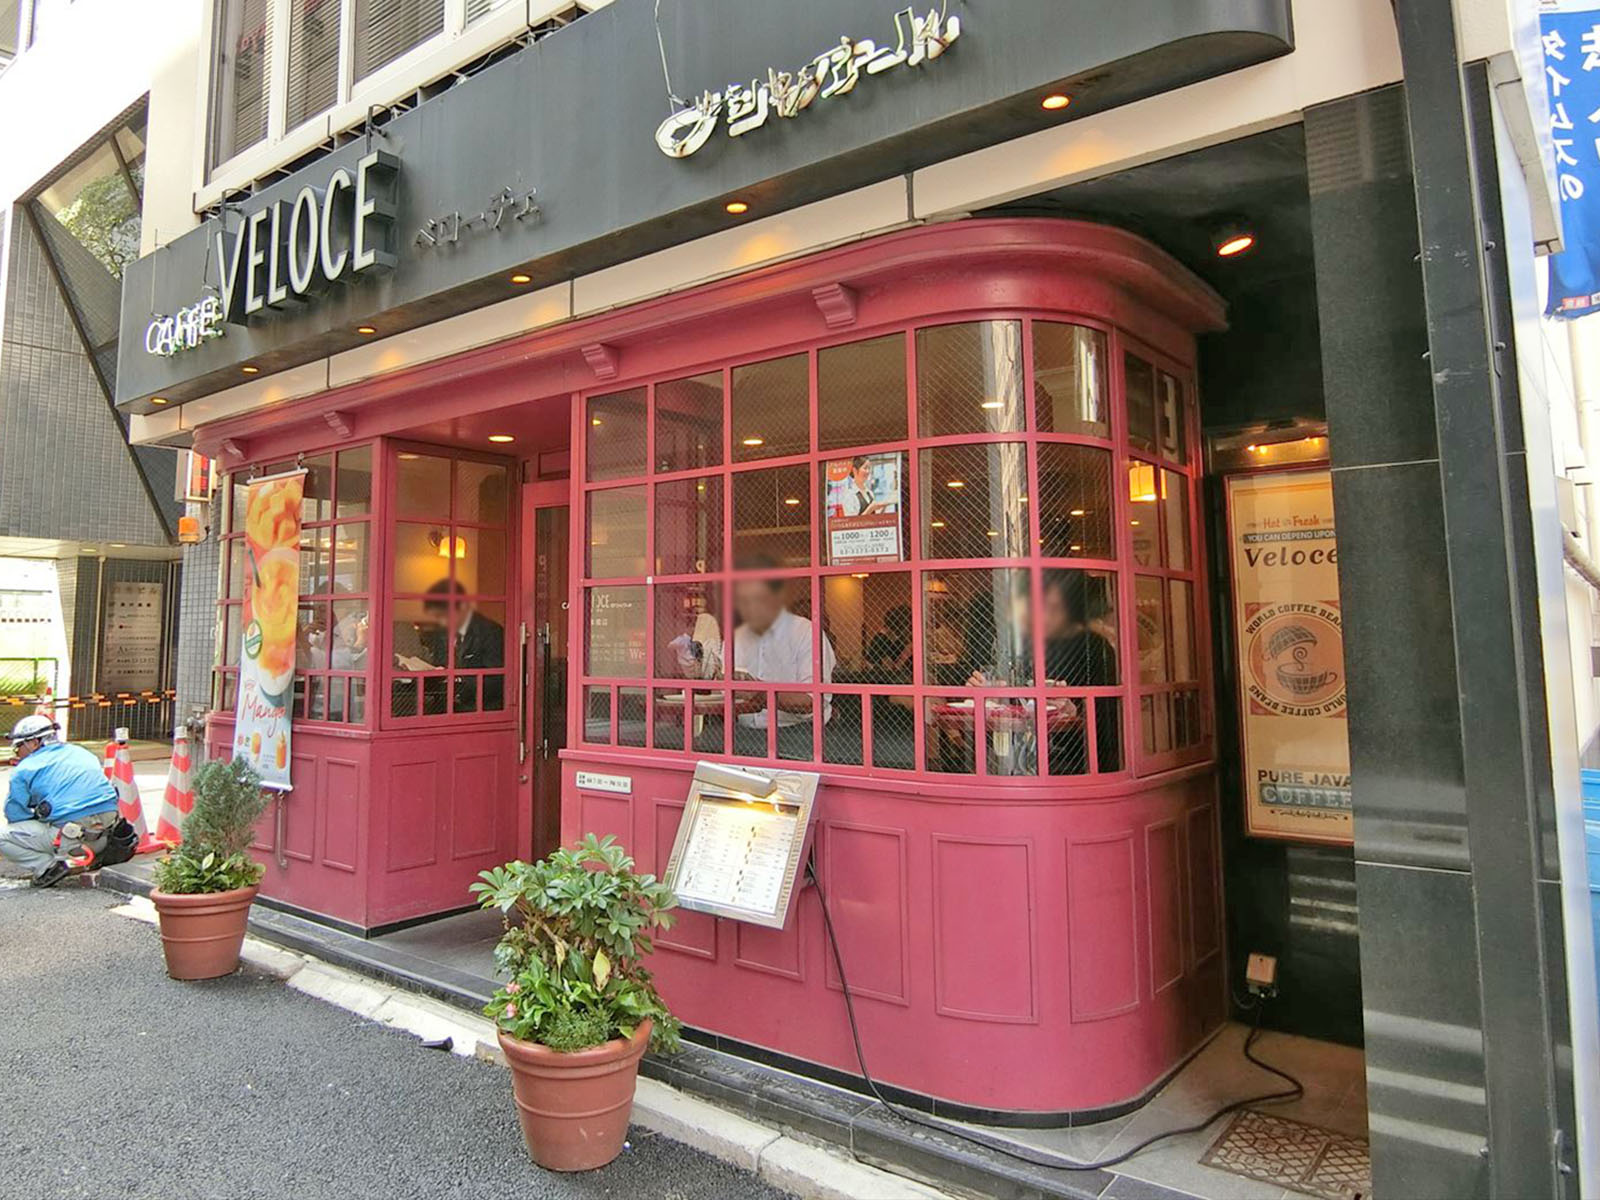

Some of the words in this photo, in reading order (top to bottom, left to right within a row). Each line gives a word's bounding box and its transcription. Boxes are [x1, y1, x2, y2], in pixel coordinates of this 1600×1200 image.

[416, 186, 541, 246] ベローチェ
[216, 149, 382, 323] VELOCE
[870, 529, 890, 538] 1200
[1264, 533, 1281, 541] CAN
[1281, 531, 1313, 540] DEPEND
[1244, 546, 1338, 568] Veloce
[1245, 609, 1276, 635] WORLD
[1277, 603, 1318, 615] COFFEE
[1248, 684, 1280, 711] BEANS
[241, 693, 287, 738] Mango
[1281, 704, 1322, 718] COFFEE
[1257, 769, 1305, 784] PURE
[1309, 773, 1352, 788] JAVA
[1261, 786, 1352, 807] COFFEE
